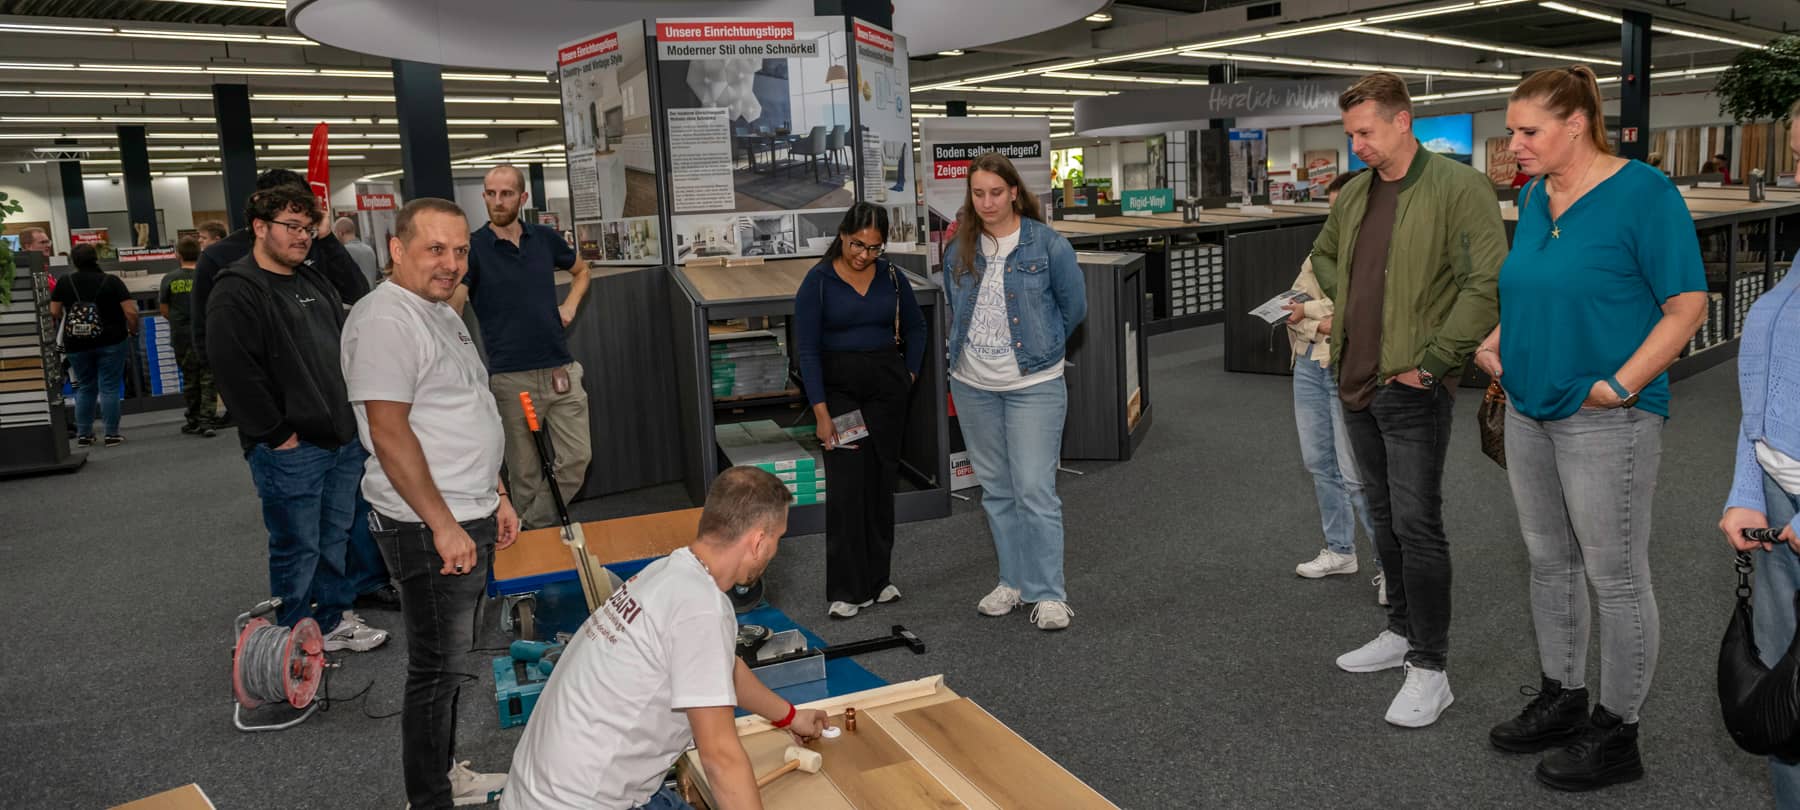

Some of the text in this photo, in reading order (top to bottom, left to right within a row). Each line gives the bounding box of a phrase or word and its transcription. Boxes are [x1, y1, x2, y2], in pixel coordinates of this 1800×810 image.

[665, 25, 793, 38] Unsere Einrichtungstipps
[577, 37, 618, 57] Einrichtungstipps
[667, 43, 816, 56] Moderner Stil ohne Schnörkel
[610, 54, 622, 67] Style
[1208, 83, 1340, 113] Herzlich Willkom
[936, 147, 966, 159] Boden
[997, 144, 1039, 158] verlegen?
[937, 164, 968, 178] Zeigen
[1129, 194, 1166, 209] Rigid-Vinyl
[957, 466, 974, 476] DEPO
